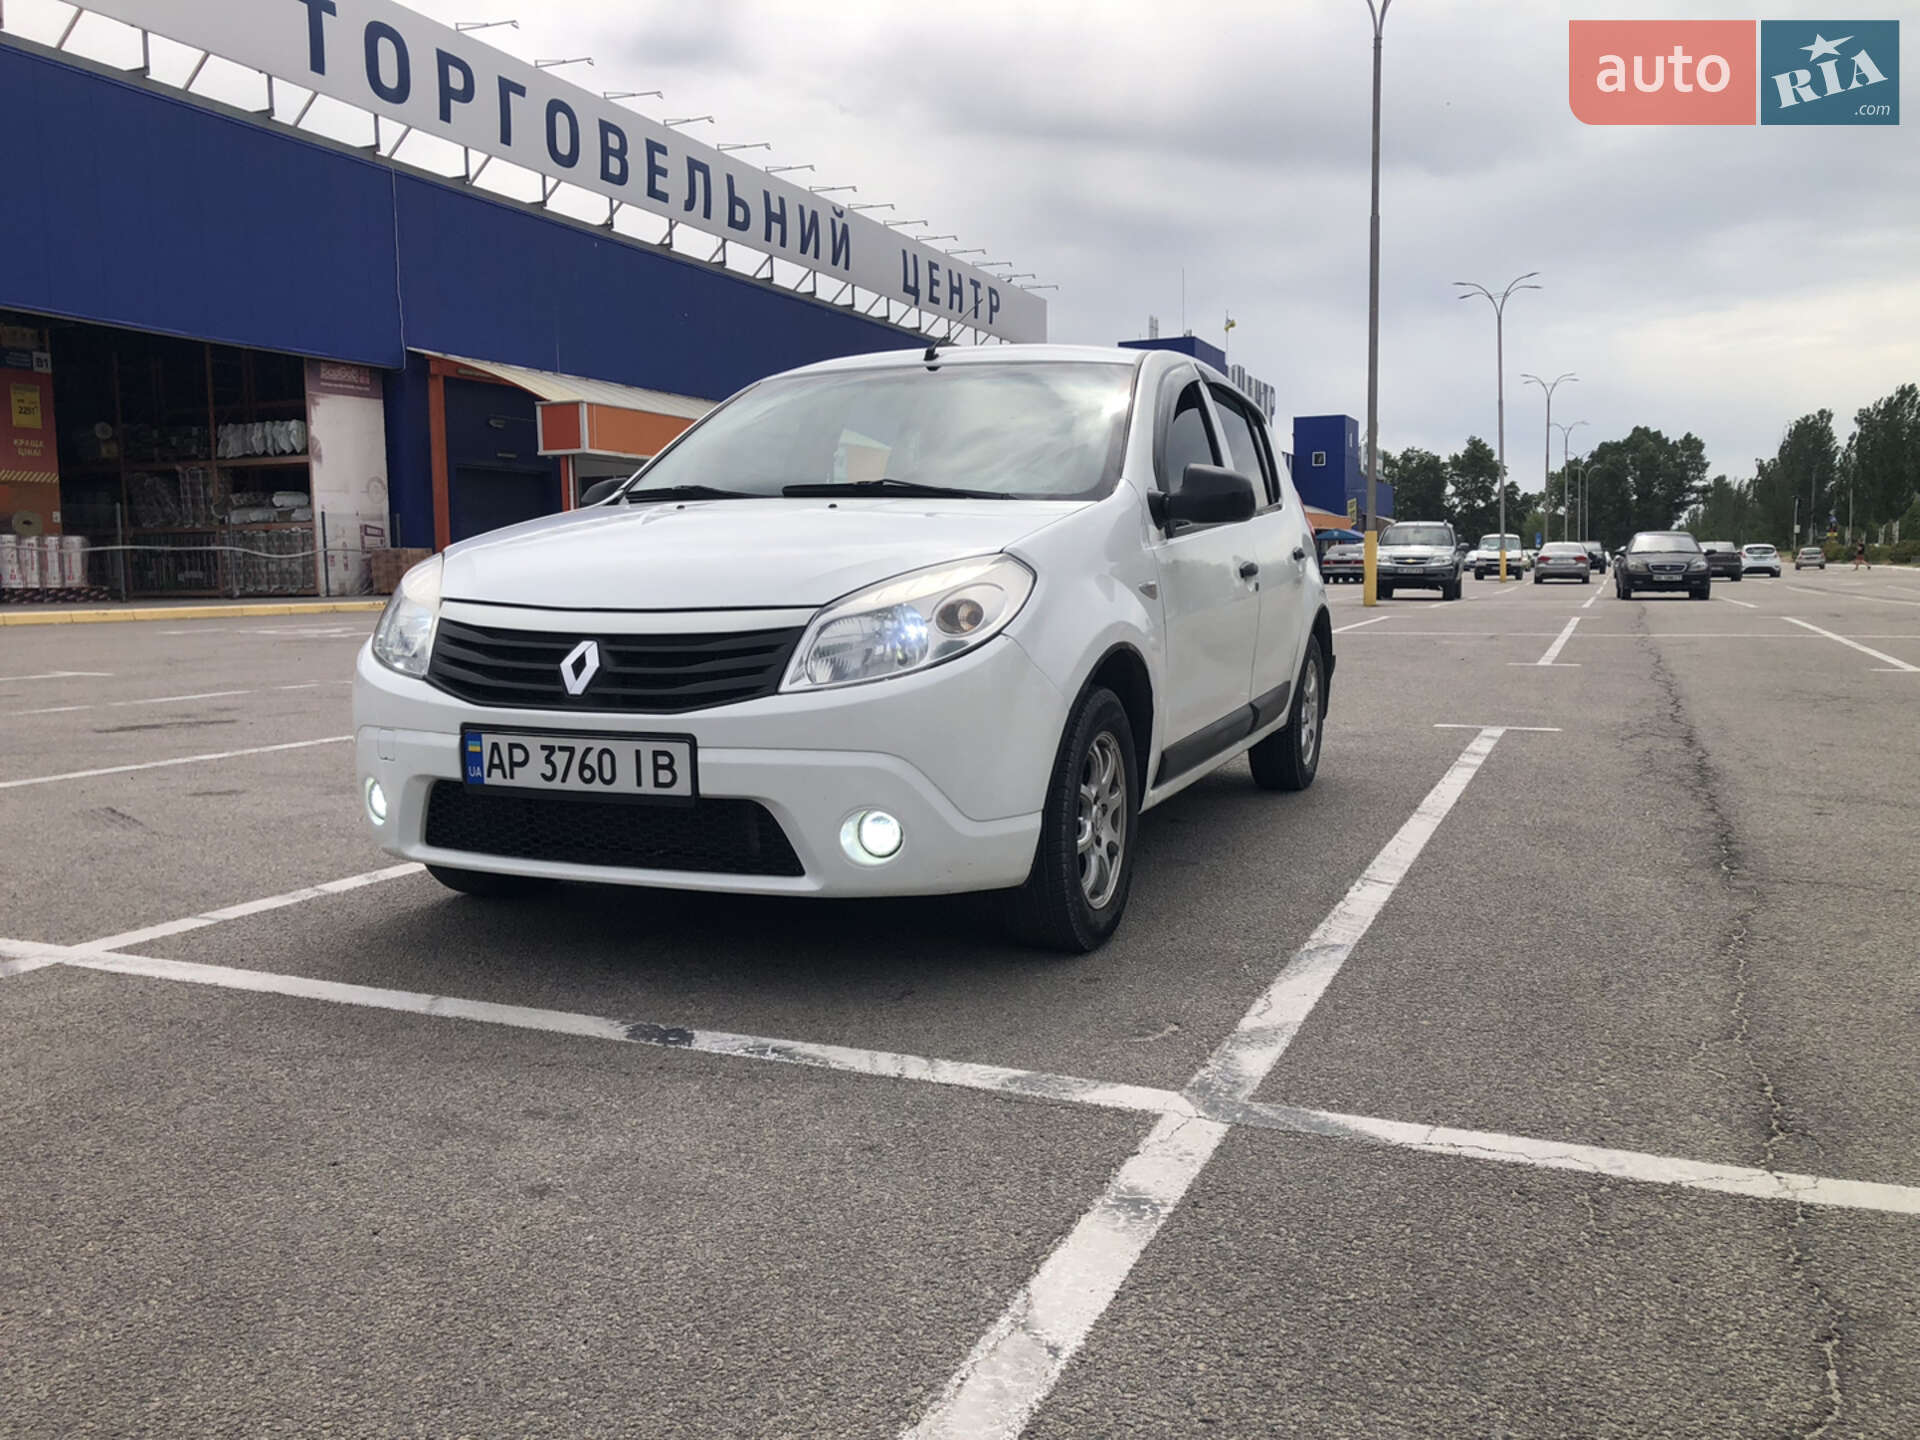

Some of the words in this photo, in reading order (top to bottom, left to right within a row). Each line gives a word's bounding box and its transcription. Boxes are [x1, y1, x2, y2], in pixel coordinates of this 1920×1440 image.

[297, 0, 850, 271] ТОРГОВЕЛЬНИЙ
[902, 249, 1000, 324] ЦЕНТР
[468, 766, 482, 777] UA
[486, 742, 530, 779] AP
[540, 744, 616, 785] 3760
[635, 749, 678, 788] IB
